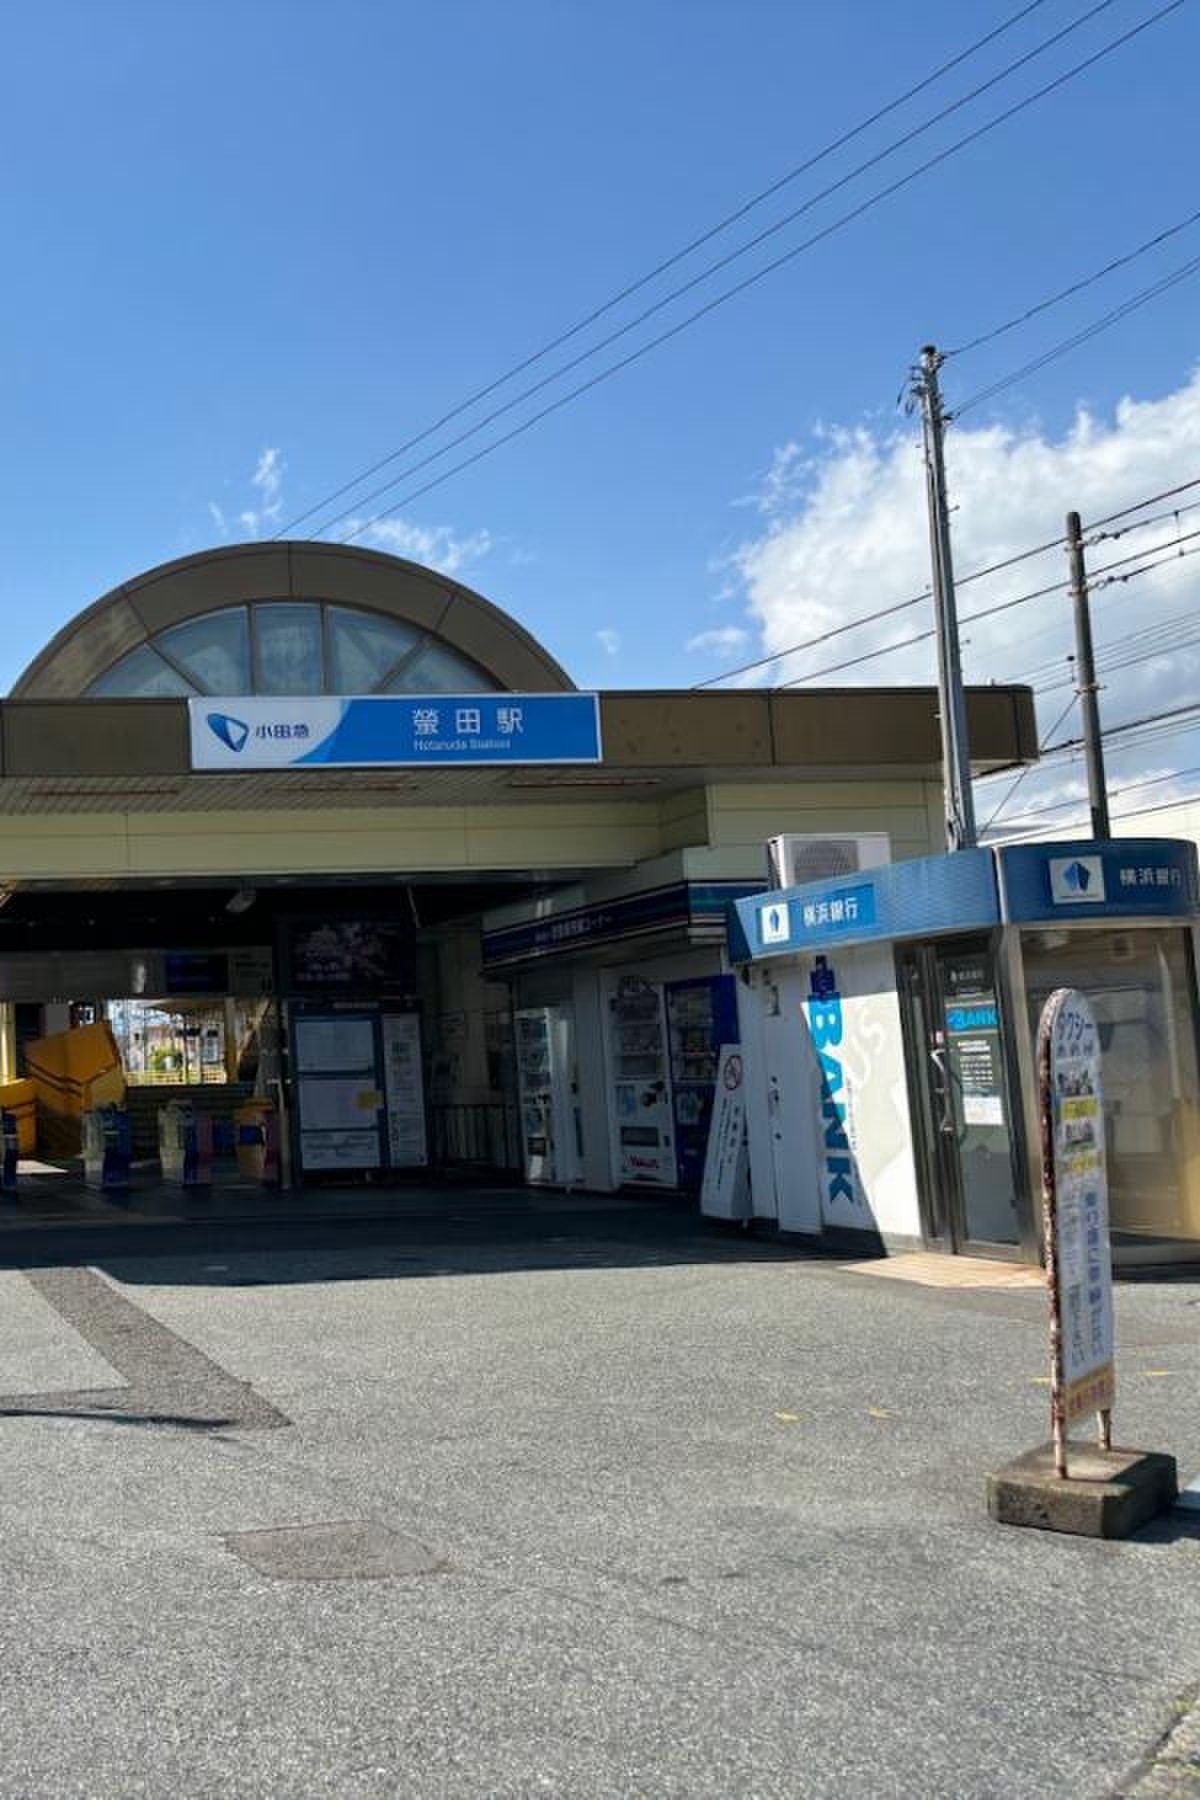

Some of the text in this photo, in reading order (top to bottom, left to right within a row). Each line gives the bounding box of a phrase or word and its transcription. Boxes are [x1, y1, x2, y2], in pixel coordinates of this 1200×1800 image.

[1120, 867, 1182, 887] 横浜銀行
[803, 897, 858, 928] 横浜銀行
[809, 992, 855, 1205] BANK
